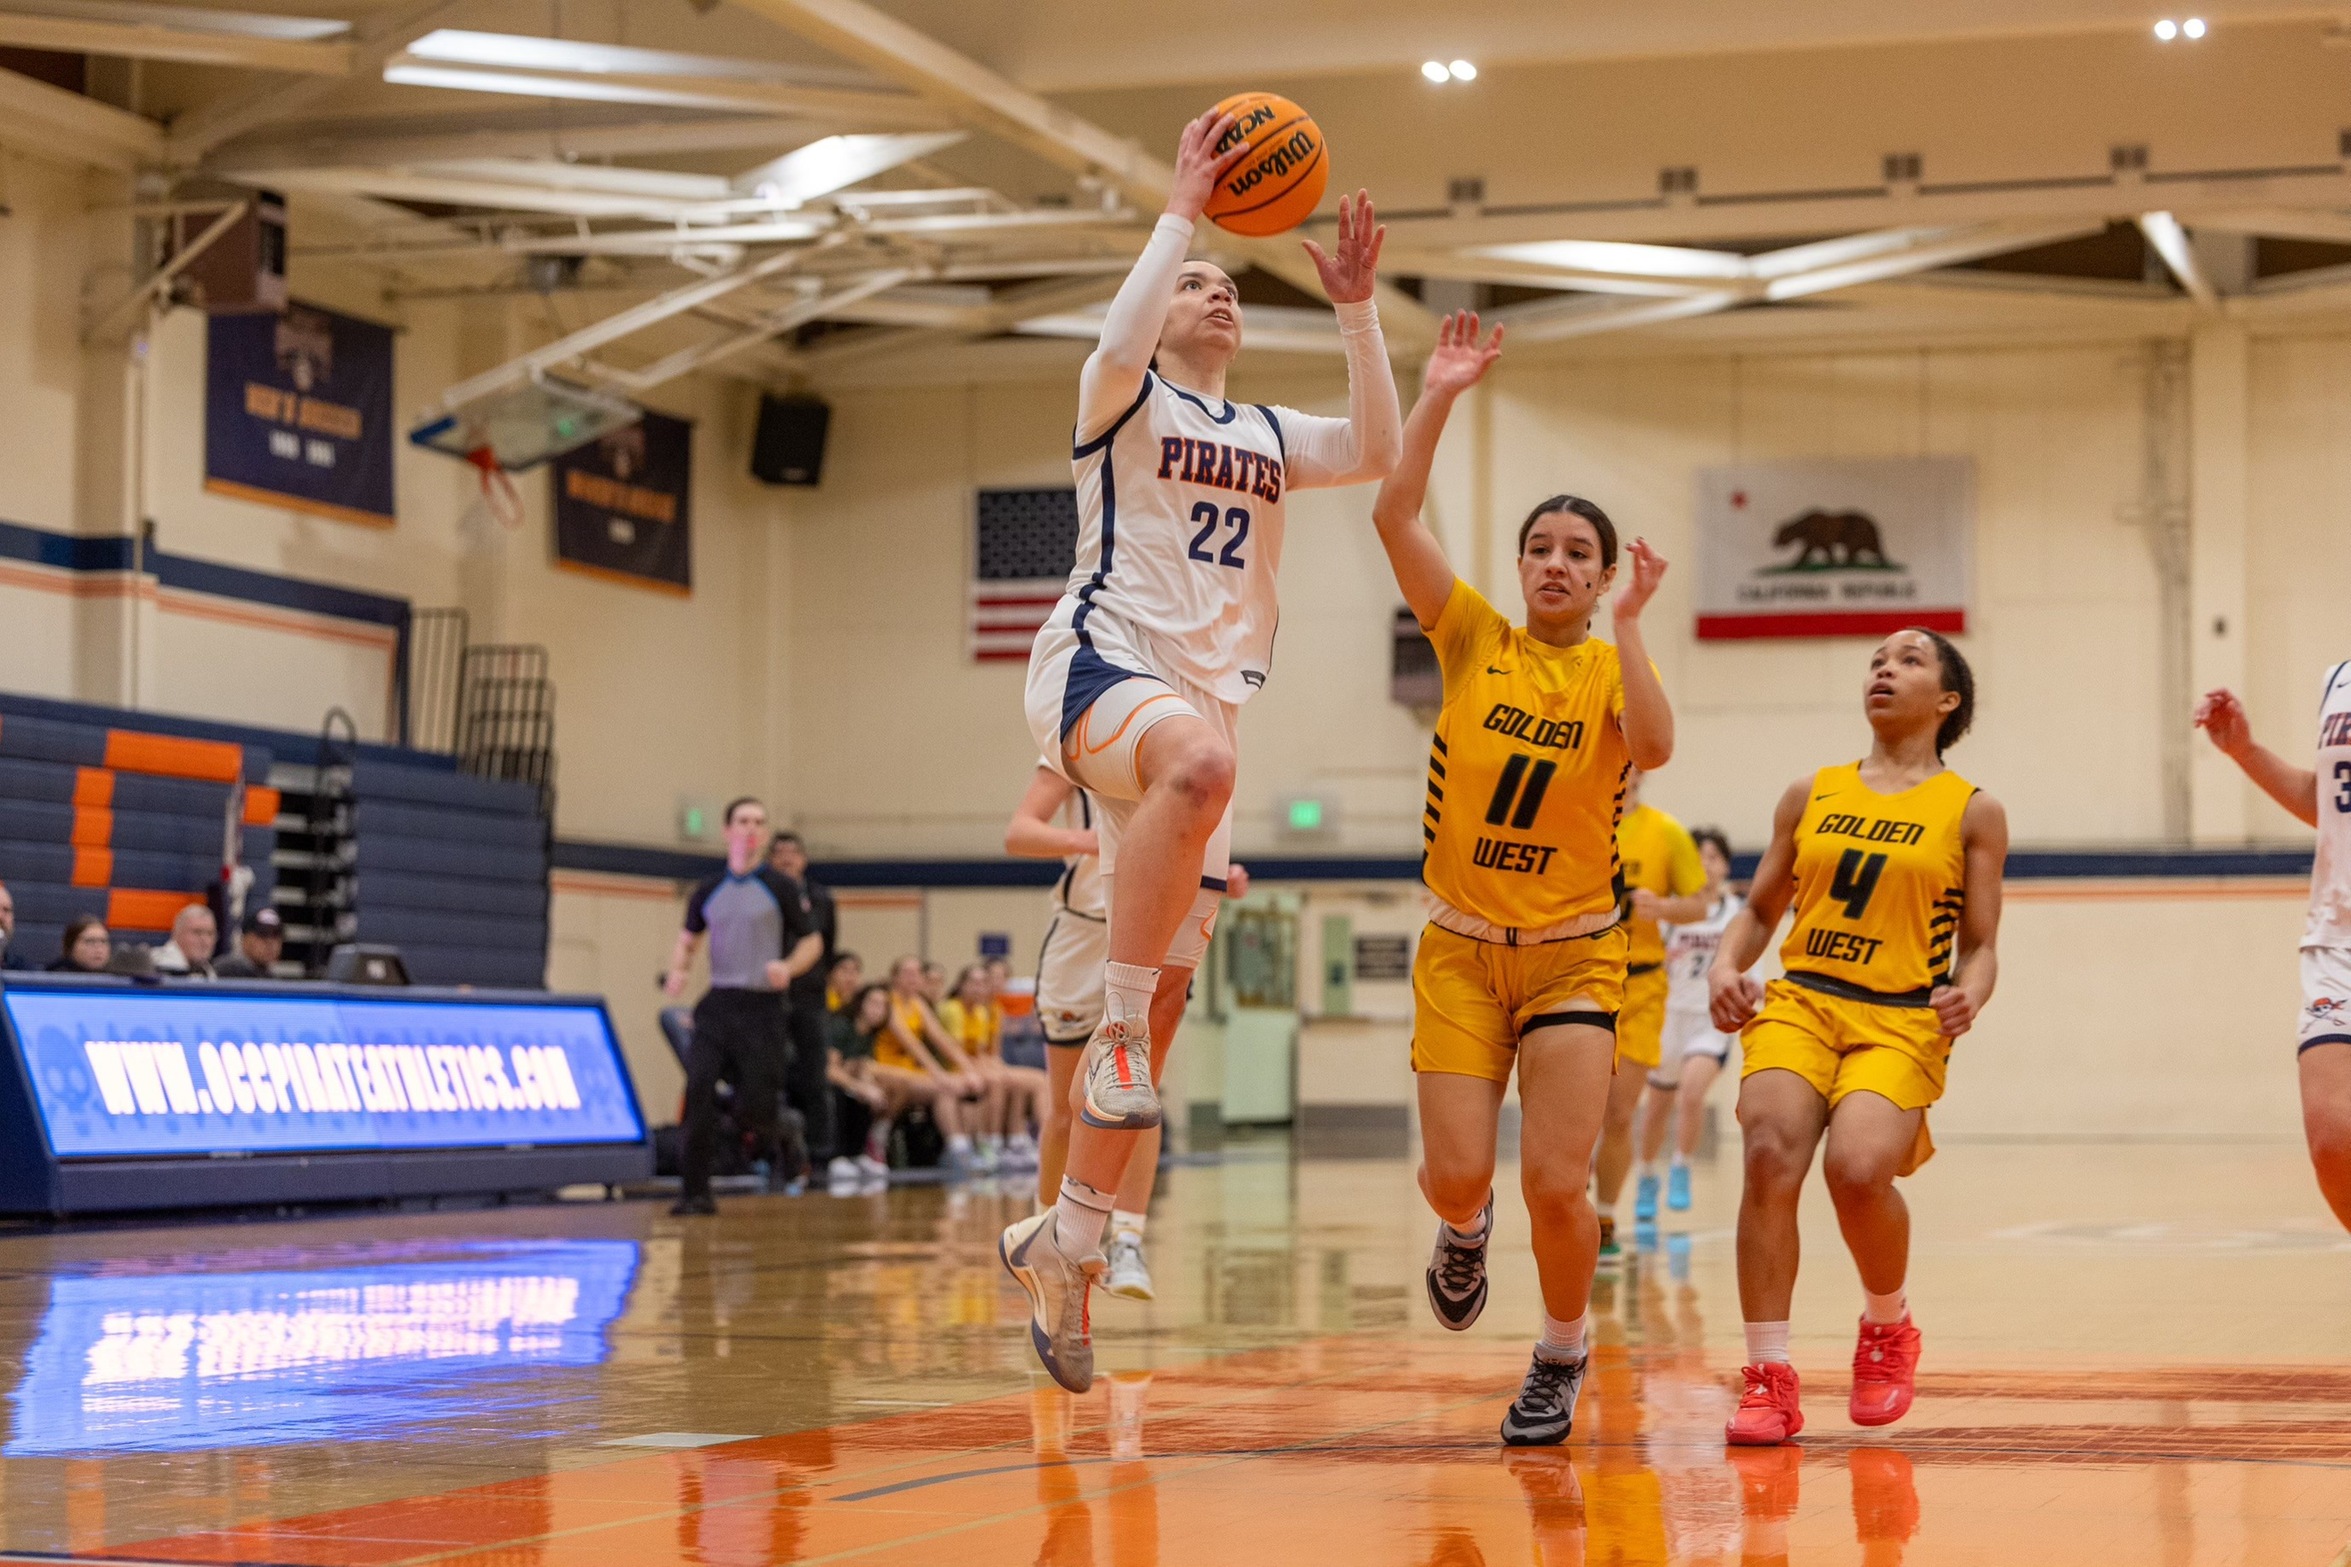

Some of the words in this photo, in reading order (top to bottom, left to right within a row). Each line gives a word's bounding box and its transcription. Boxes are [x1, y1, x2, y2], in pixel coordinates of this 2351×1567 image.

[1228, 130, 1315, 196] Wilson
[1157, 436, 1282, 505] PIRATES
[1188, 501, 1250, 570] 22
[1483, 703, 1584, 749] GOLDEN
[1485, 753, 1557, 830] 11
[1473, 837, 1558, 875] WEST
[1816, 814, 1925, 846] GOLDEN
[1829, 848, 1888, 920] 4
[1806, 928, 1884, 965] WEST
[84, 1040, 582, 1115] WWW.OCCPIRATEATHLETICS.COM
